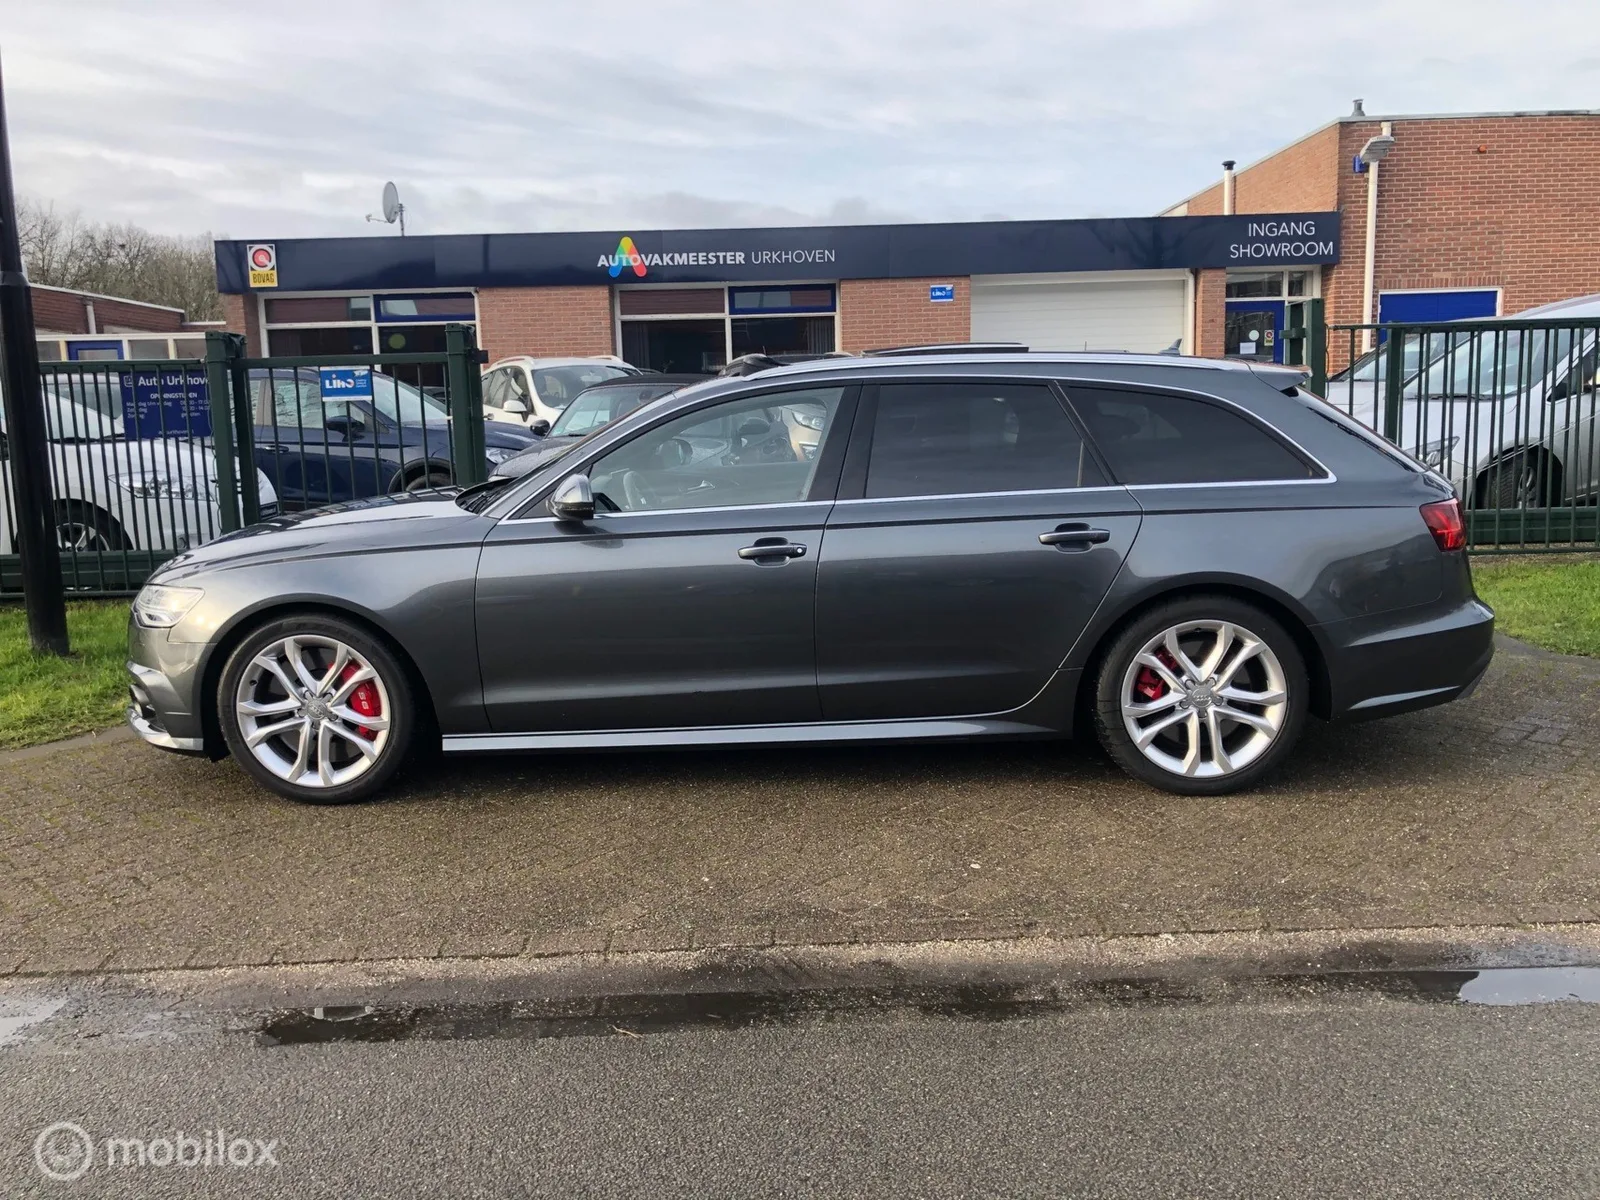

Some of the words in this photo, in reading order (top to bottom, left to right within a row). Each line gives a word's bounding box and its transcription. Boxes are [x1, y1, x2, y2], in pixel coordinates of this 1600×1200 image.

[1248, 221, 1316, 237] INGANG
[597, 252, 746, 267] AUTOVAKMEESTER
[751, 249, 836, 265] URKHOVEN
[1230, 241, 1334, 258] SHOWROOM
